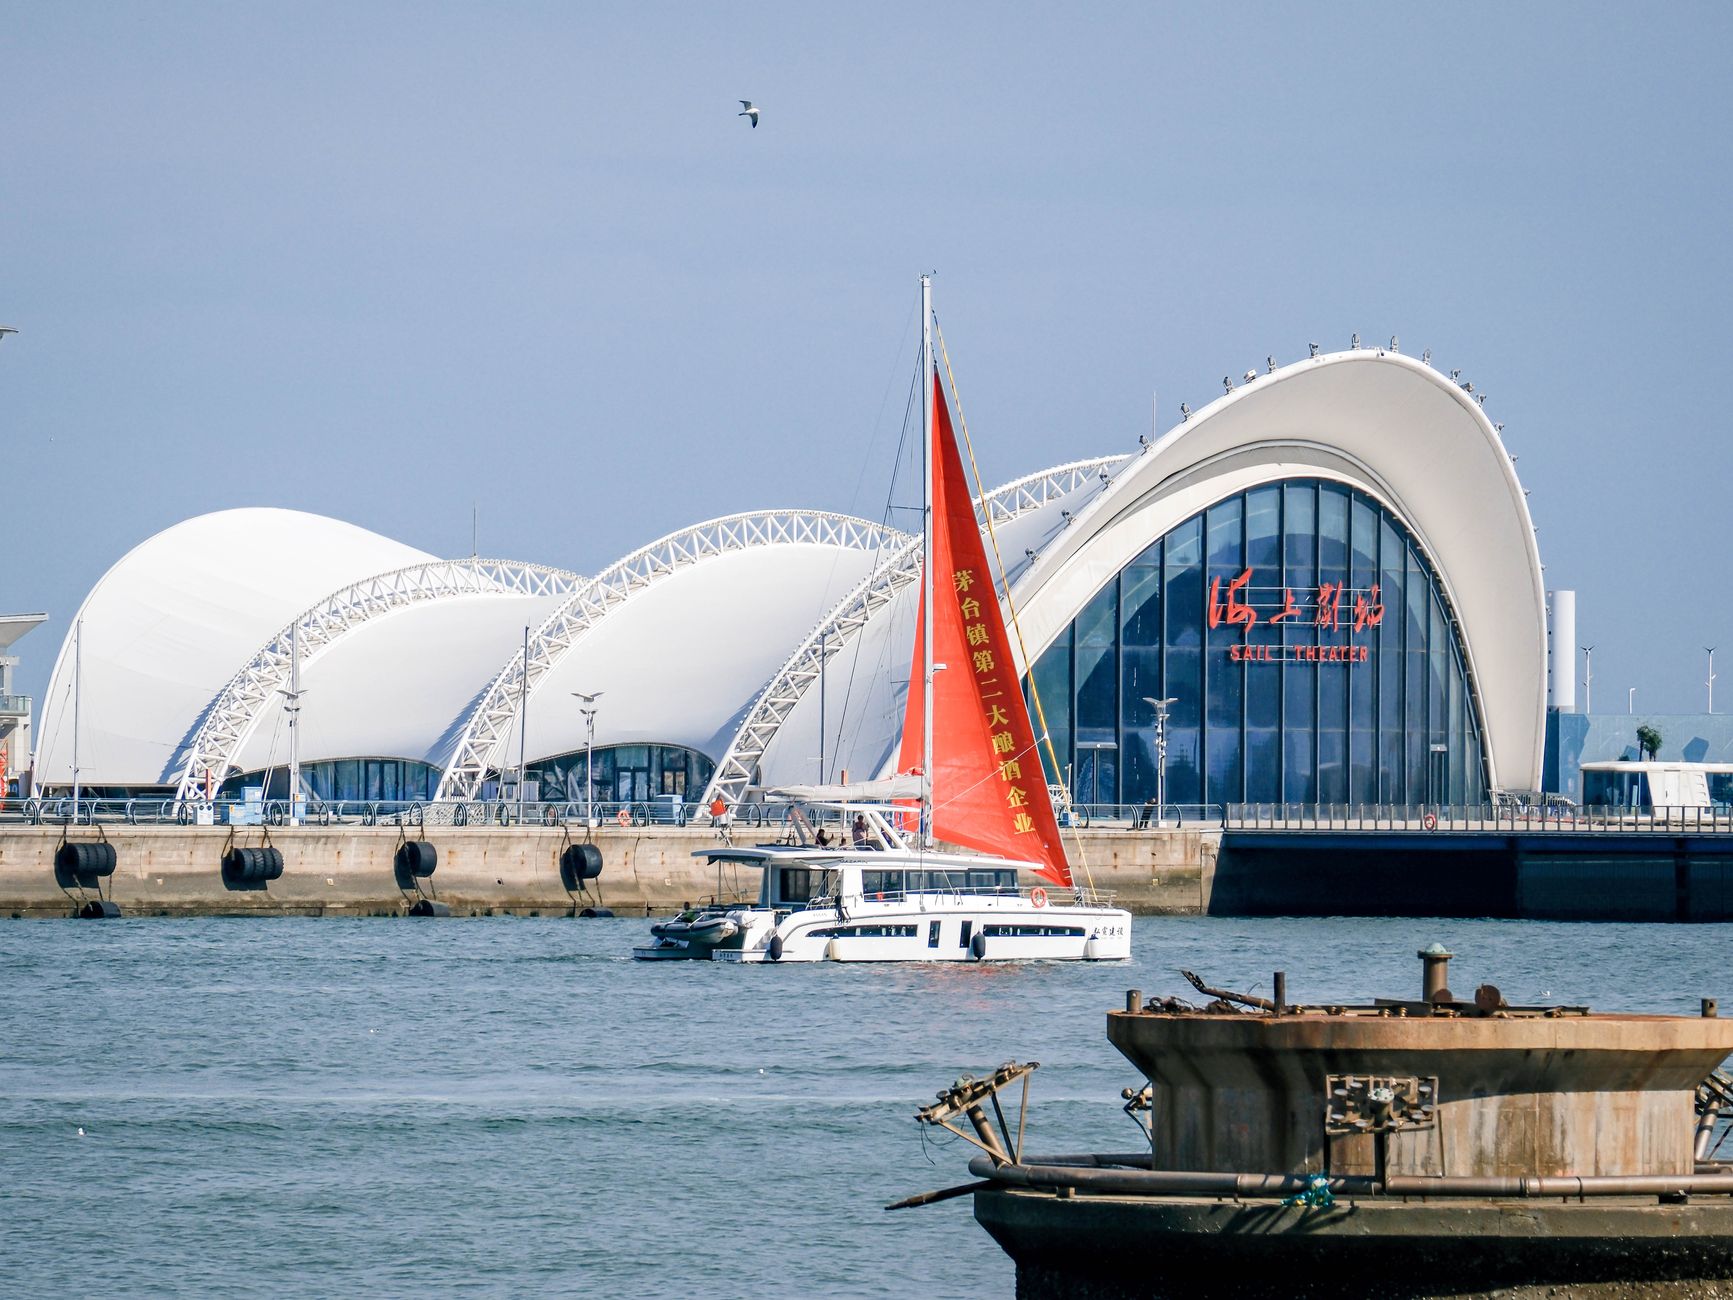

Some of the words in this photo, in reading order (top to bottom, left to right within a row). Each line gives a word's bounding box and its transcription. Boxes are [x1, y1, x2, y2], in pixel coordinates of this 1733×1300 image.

[952, 569, 1036, 835] 茅台镇第二大酿酒企业
[1231, 645, 1272, 661] SAIL
[1295, 645, 1368, 662] THEATER
